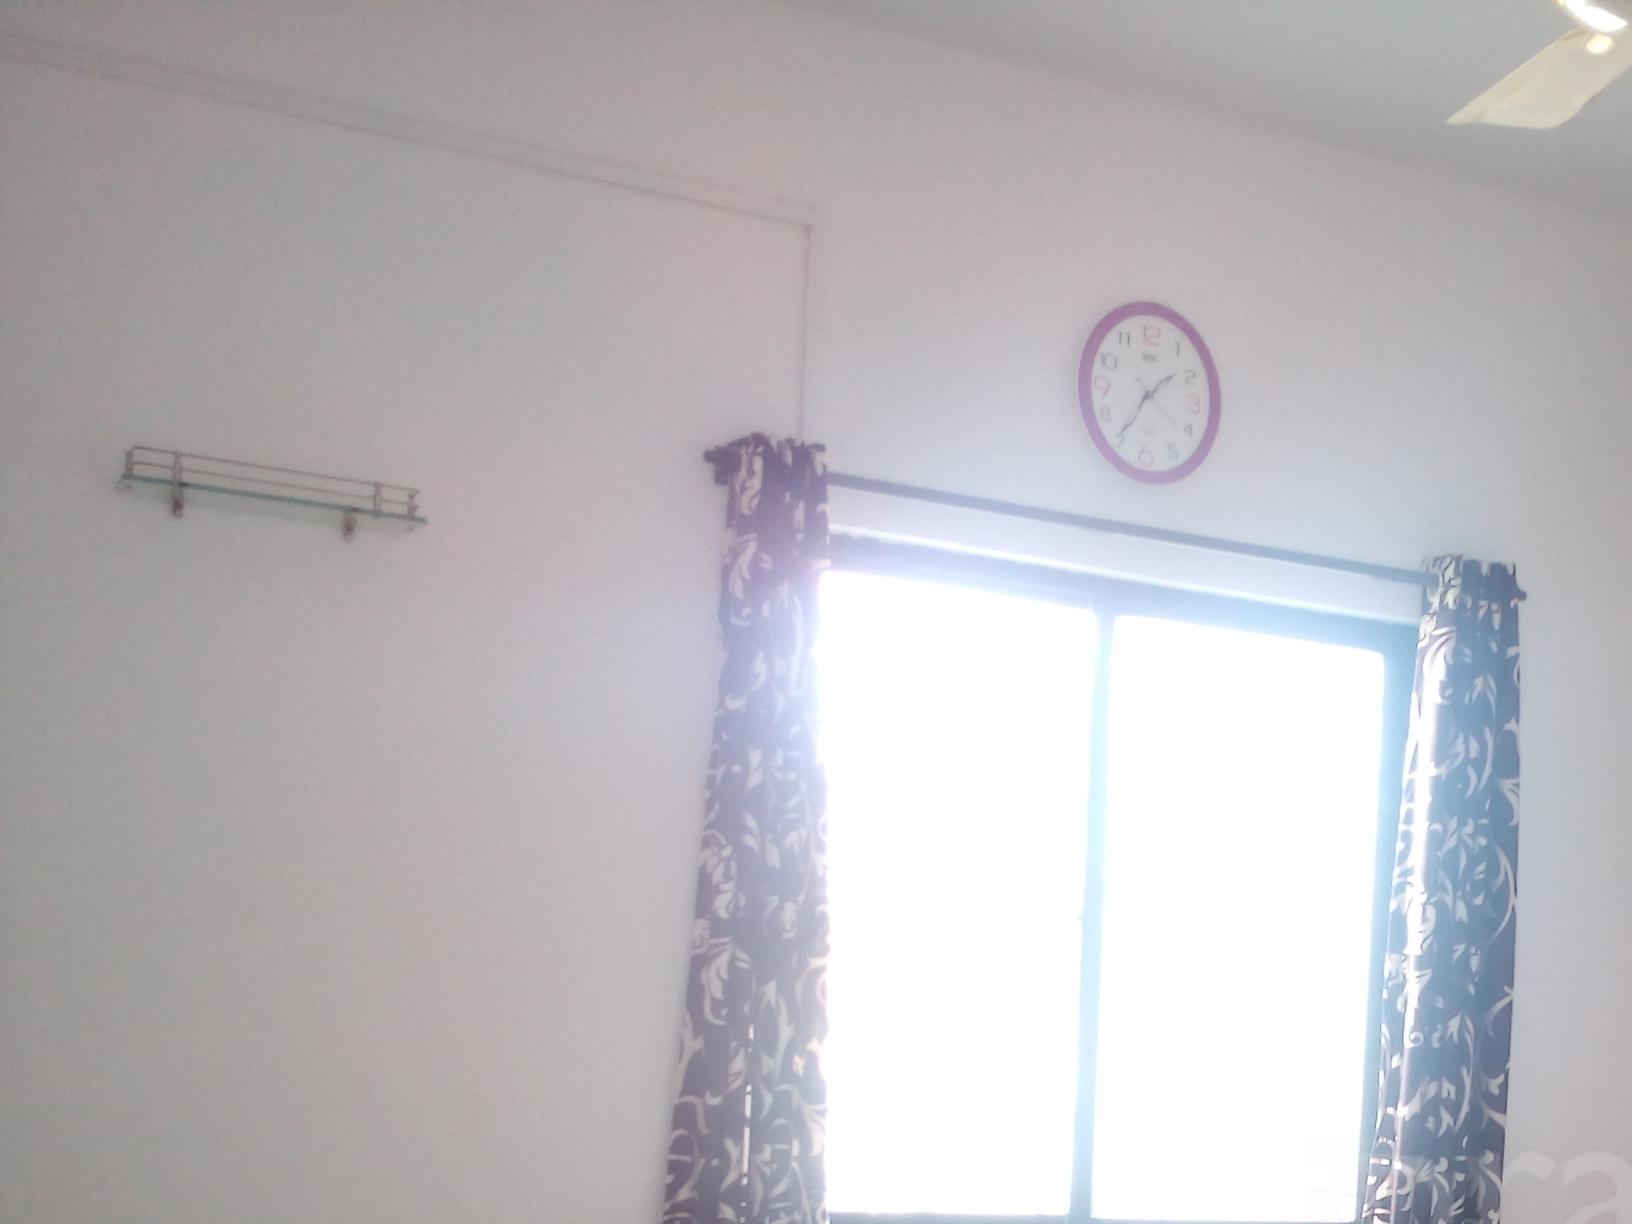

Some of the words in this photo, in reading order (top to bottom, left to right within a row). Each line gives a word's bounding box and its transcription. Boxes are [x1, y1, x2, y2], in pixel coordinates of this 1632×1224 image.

[1117, 331, 1130, 348] 11
[1143, 326, 1160, 346] 12
[1175, 342, 1181, 357] 1
[1100, 352, 1118, 370] 10
[1184, 369, 1197, 385] 2
[1094, 376, 1111, 398] 9
[1183, 424, 1193, 438] 4
